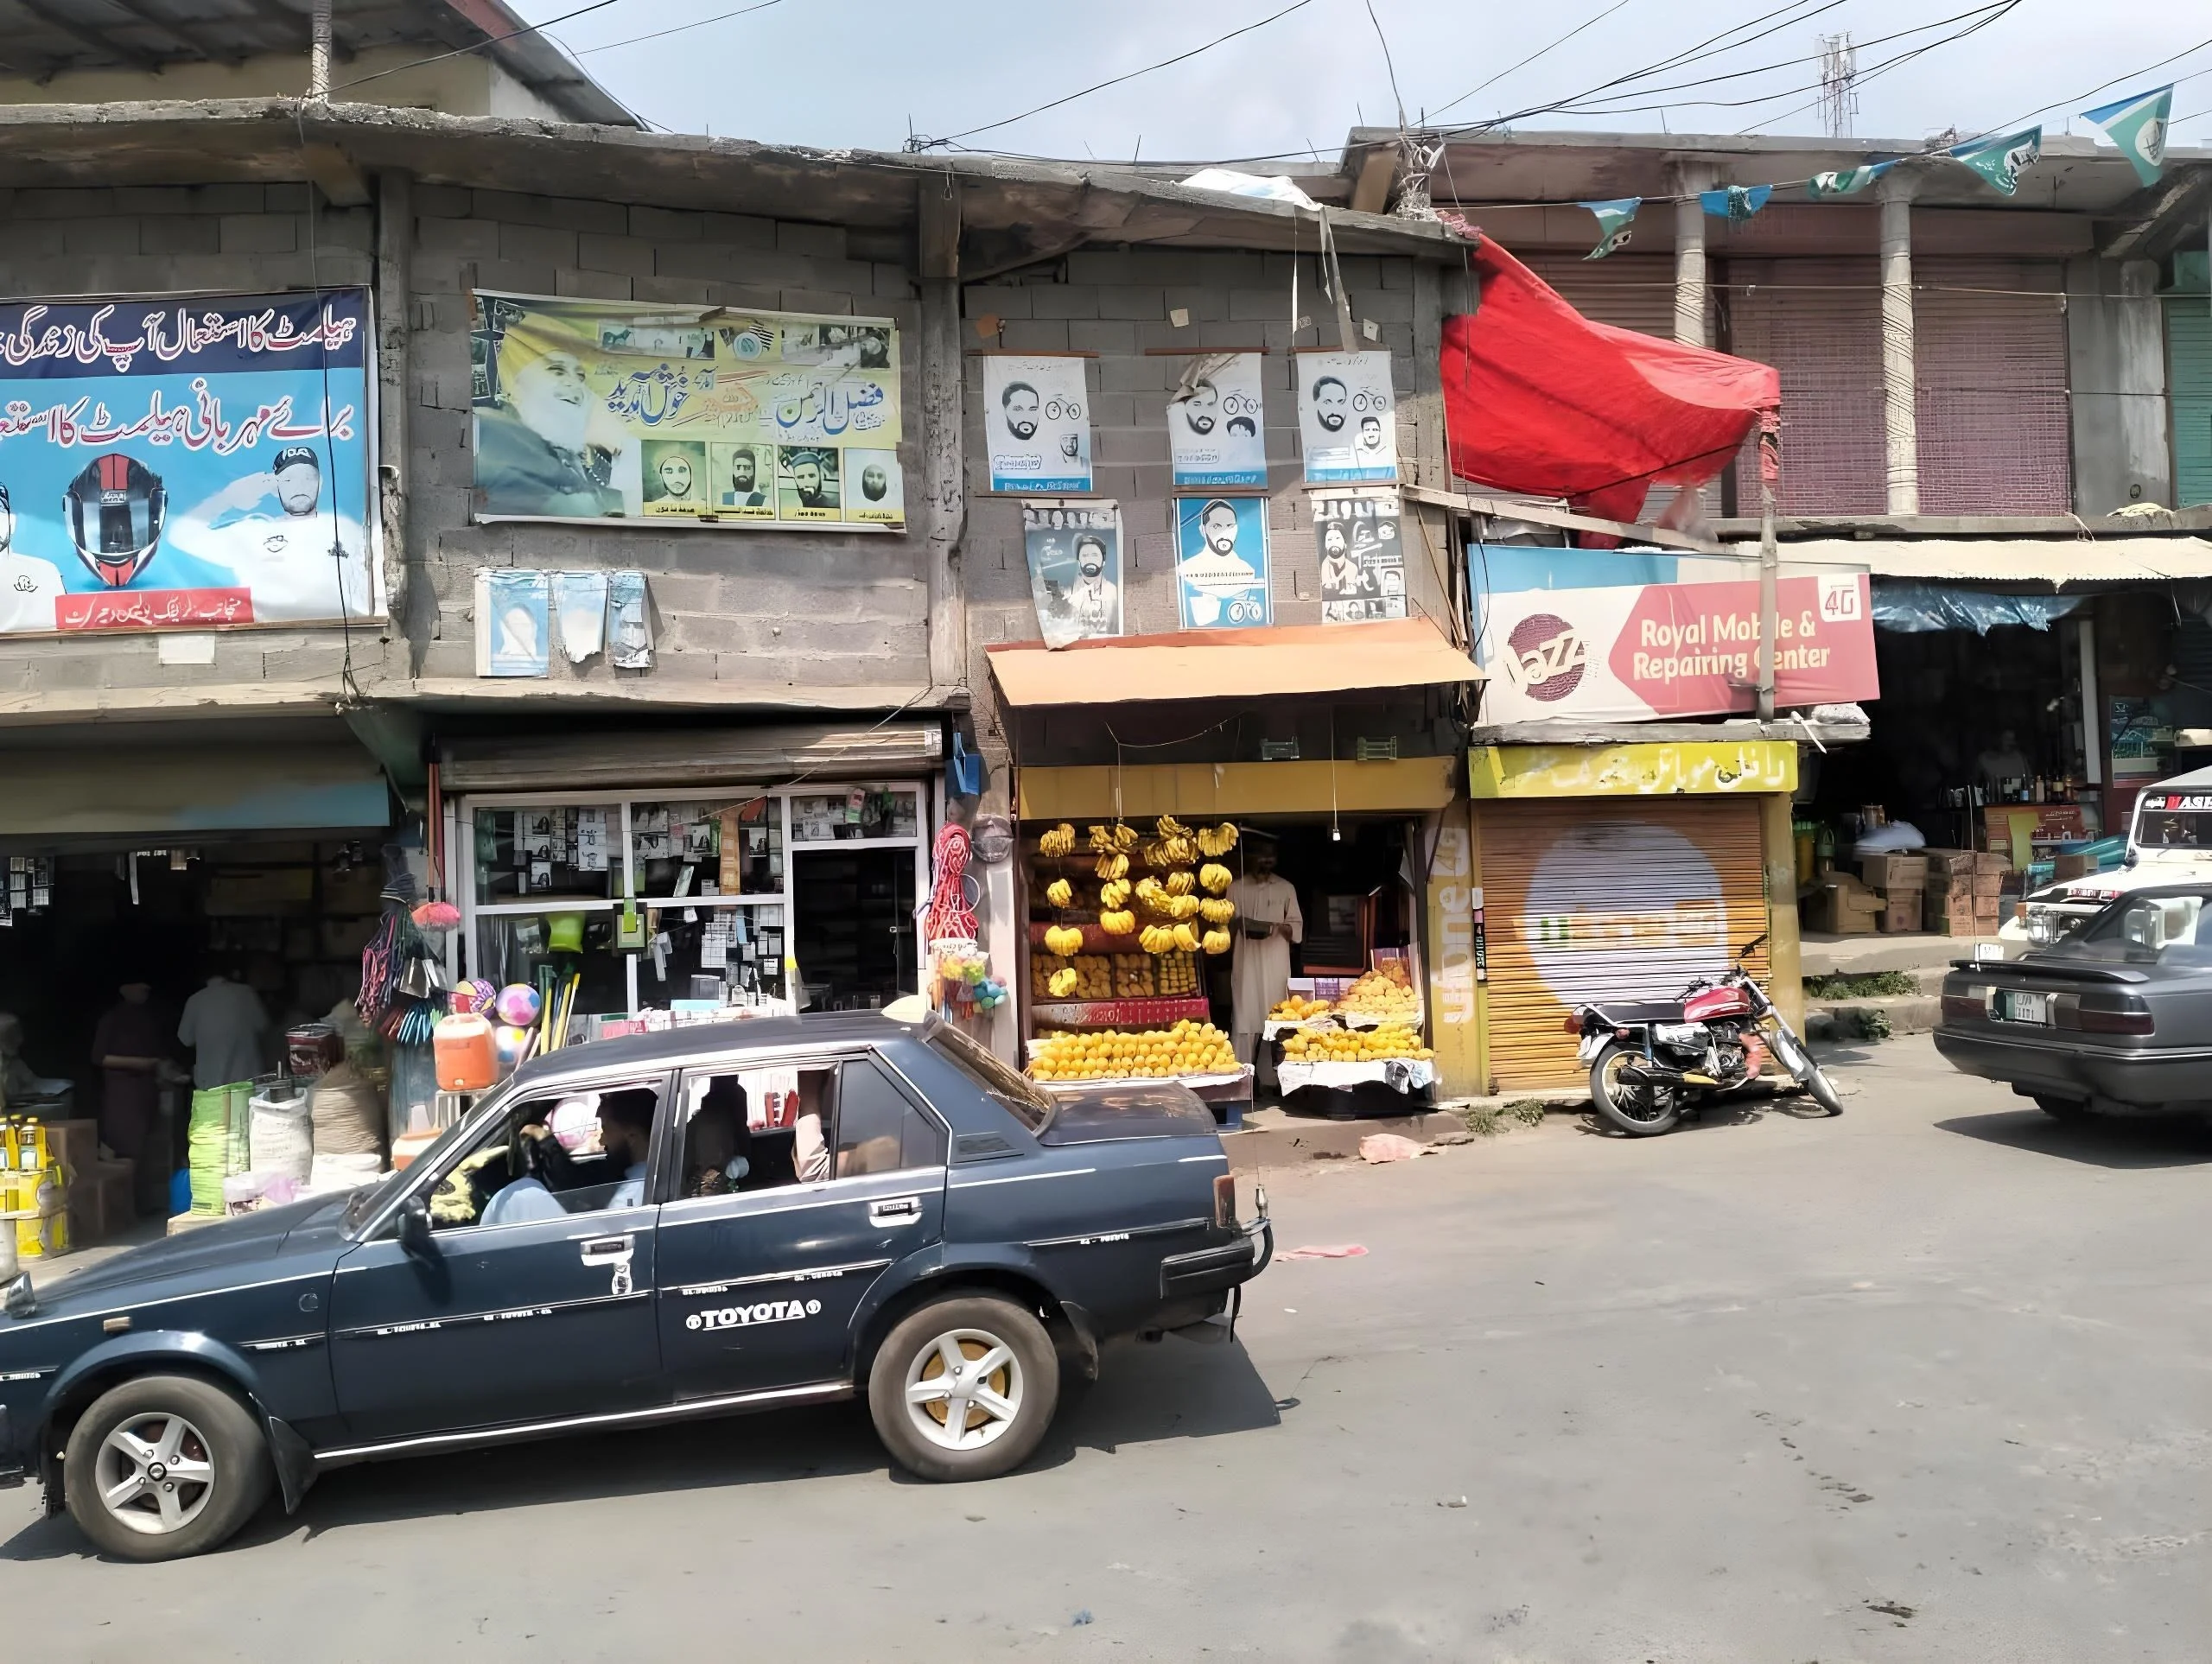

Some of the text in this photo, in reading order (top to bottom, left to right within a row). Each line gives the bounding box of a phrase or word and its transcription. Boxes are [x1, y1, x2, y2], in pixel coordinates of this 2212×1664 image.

[75, 304, 114, 364] کی
[102, 311, 166, 372] آپ
[156, 308, 247, 360] استعمال
[1642, 611, 1816, 656] Royal Moble &
[1633, 646, 1747, 684] Repairing
[701, 1299, 806, 1328] TOYOTA
